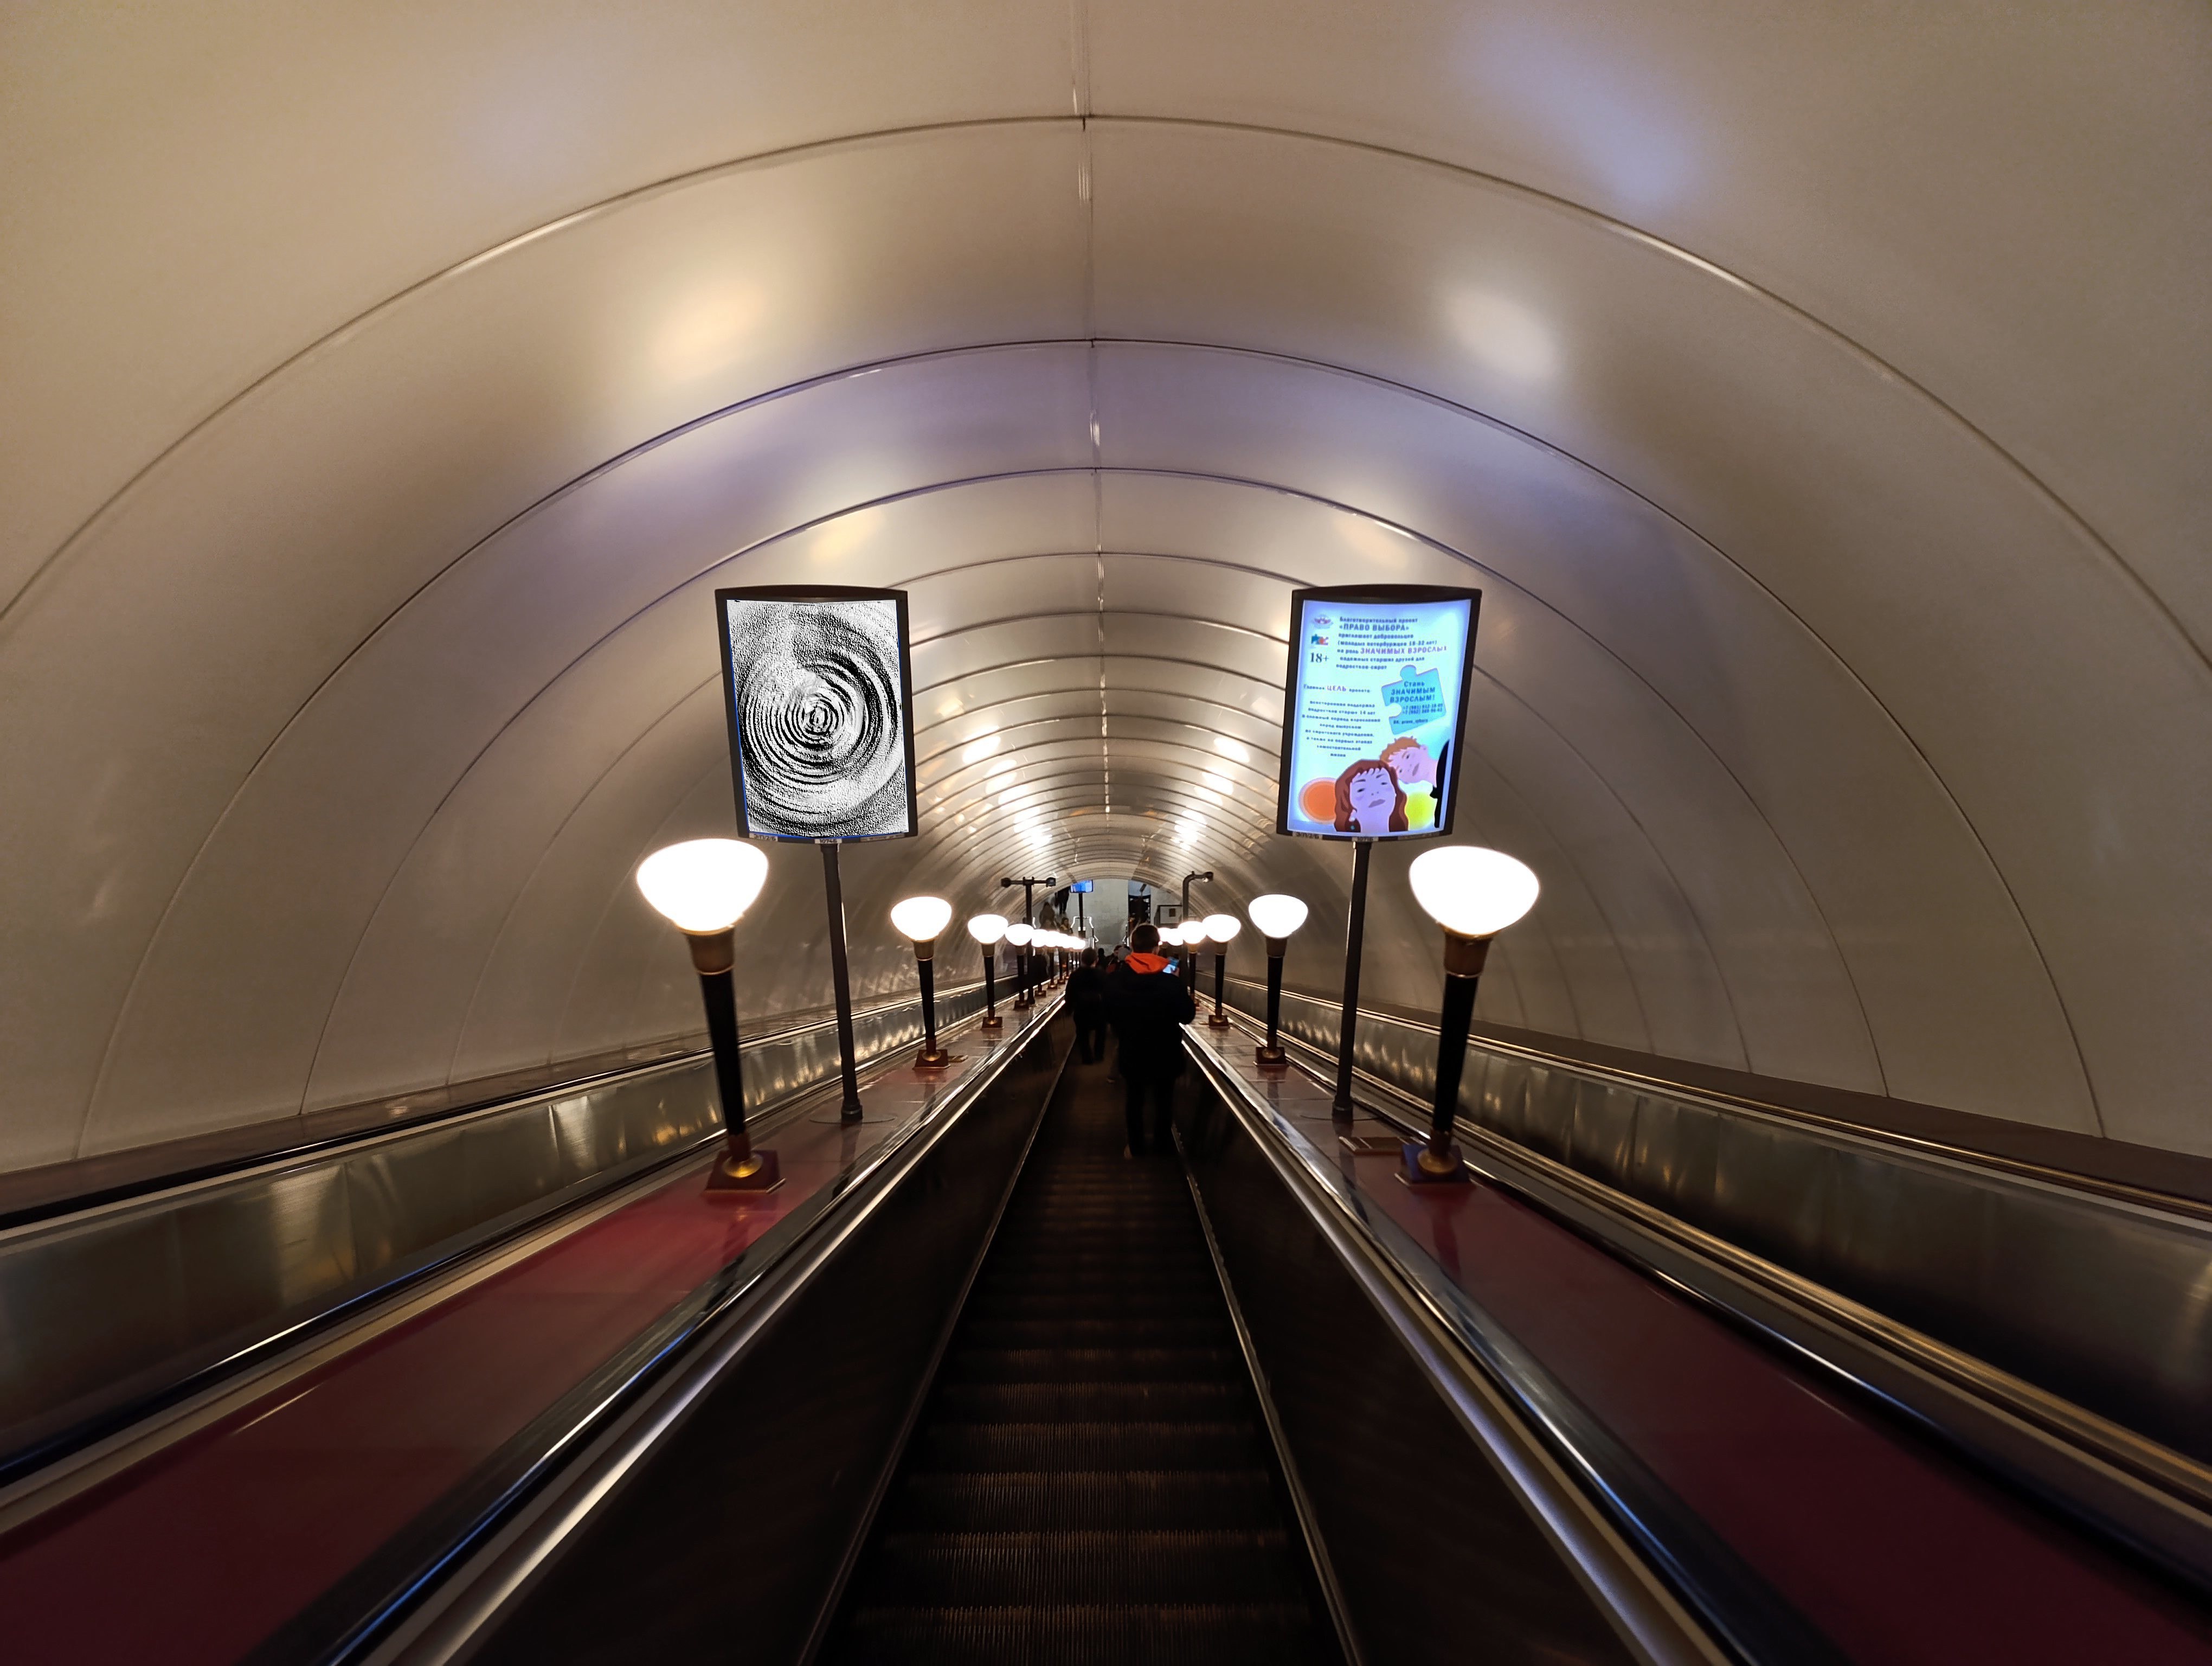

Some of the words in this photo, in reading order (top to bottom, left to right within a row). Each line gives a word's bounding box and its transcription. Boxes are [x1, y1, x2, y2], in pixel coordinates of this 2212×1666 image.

[1407, 646, 1447, 654] ВЗРОСЛЫХ
[1310, 652, 1330, 663] 18+
[1391, 687, 1436, 695] ЗНАЧИМЫМ
[1390, 694, 1435, 703] ВЗРОСЛЫМ!
